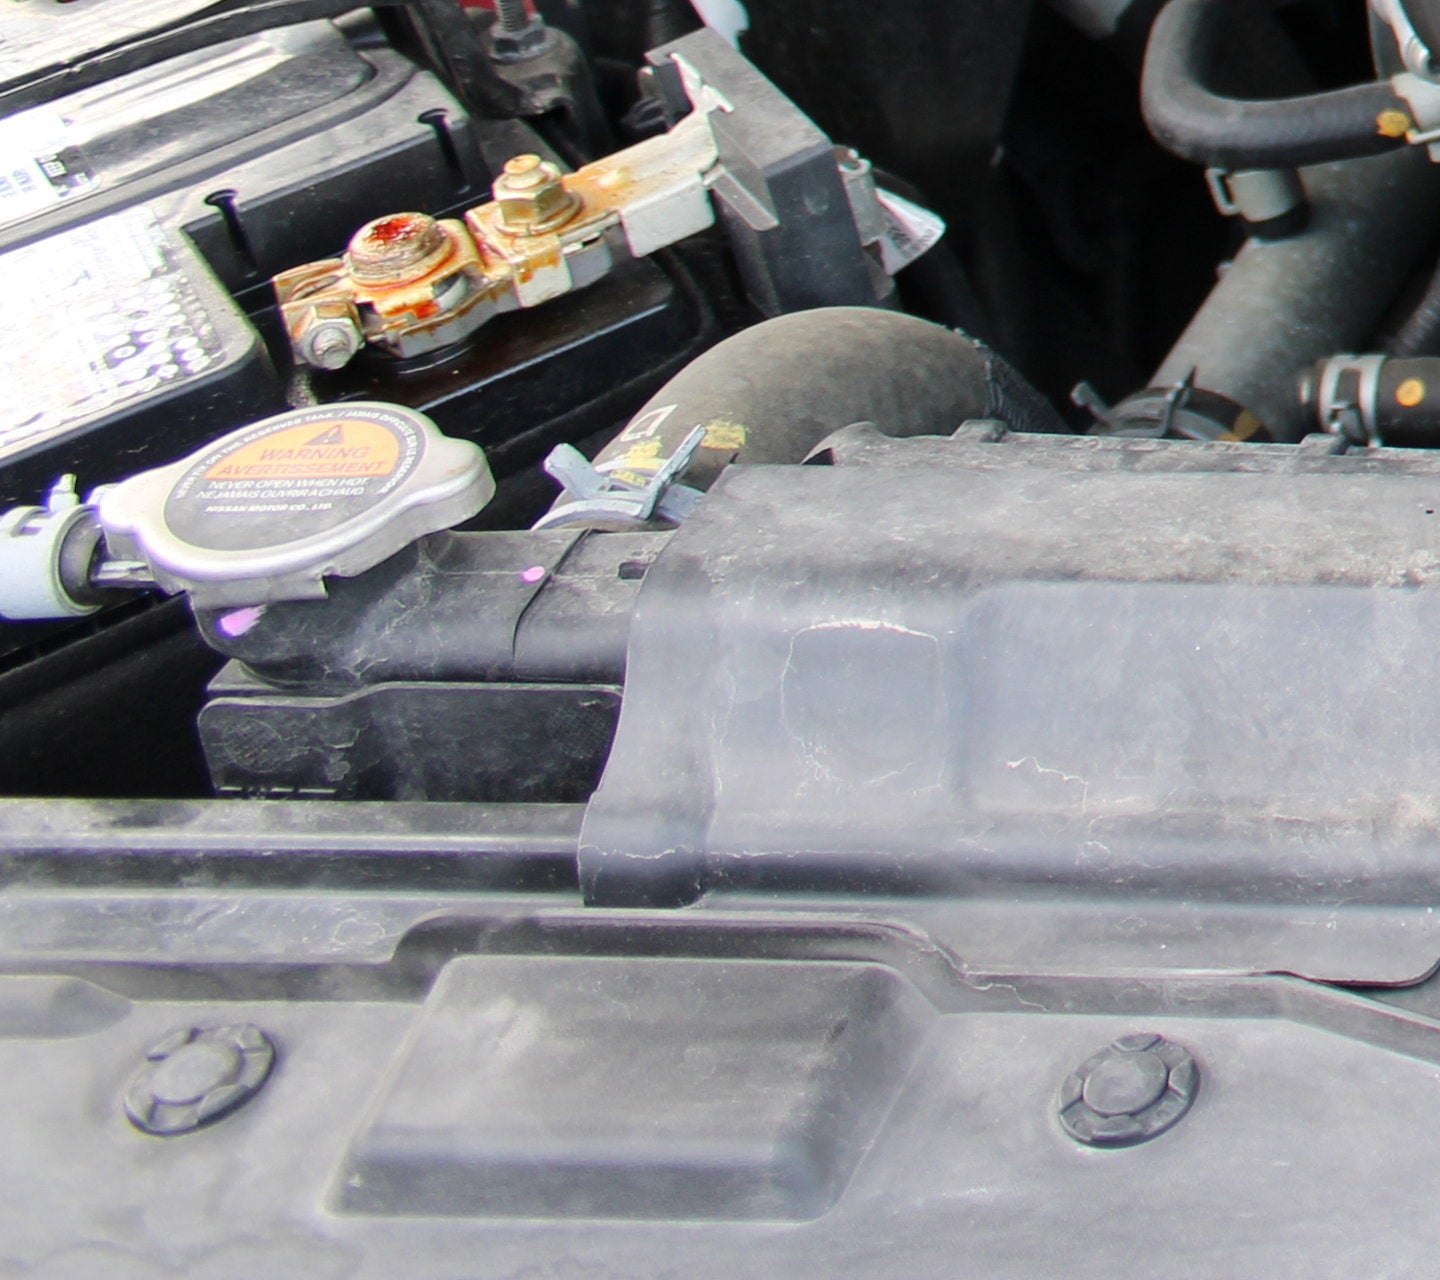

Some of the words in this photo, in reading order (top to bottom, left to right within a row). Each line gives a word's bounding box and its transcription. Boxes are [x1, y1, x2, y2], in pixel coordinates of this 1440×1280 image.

[260, 446, 371, 461] WARNING
[219, 461, 387, 476] AVERTISSEMENT
[208, 479, 255, 489] NEVER
[256, 479, 294, 488] OPEN
[297, 478, 338, 487] WHEN
